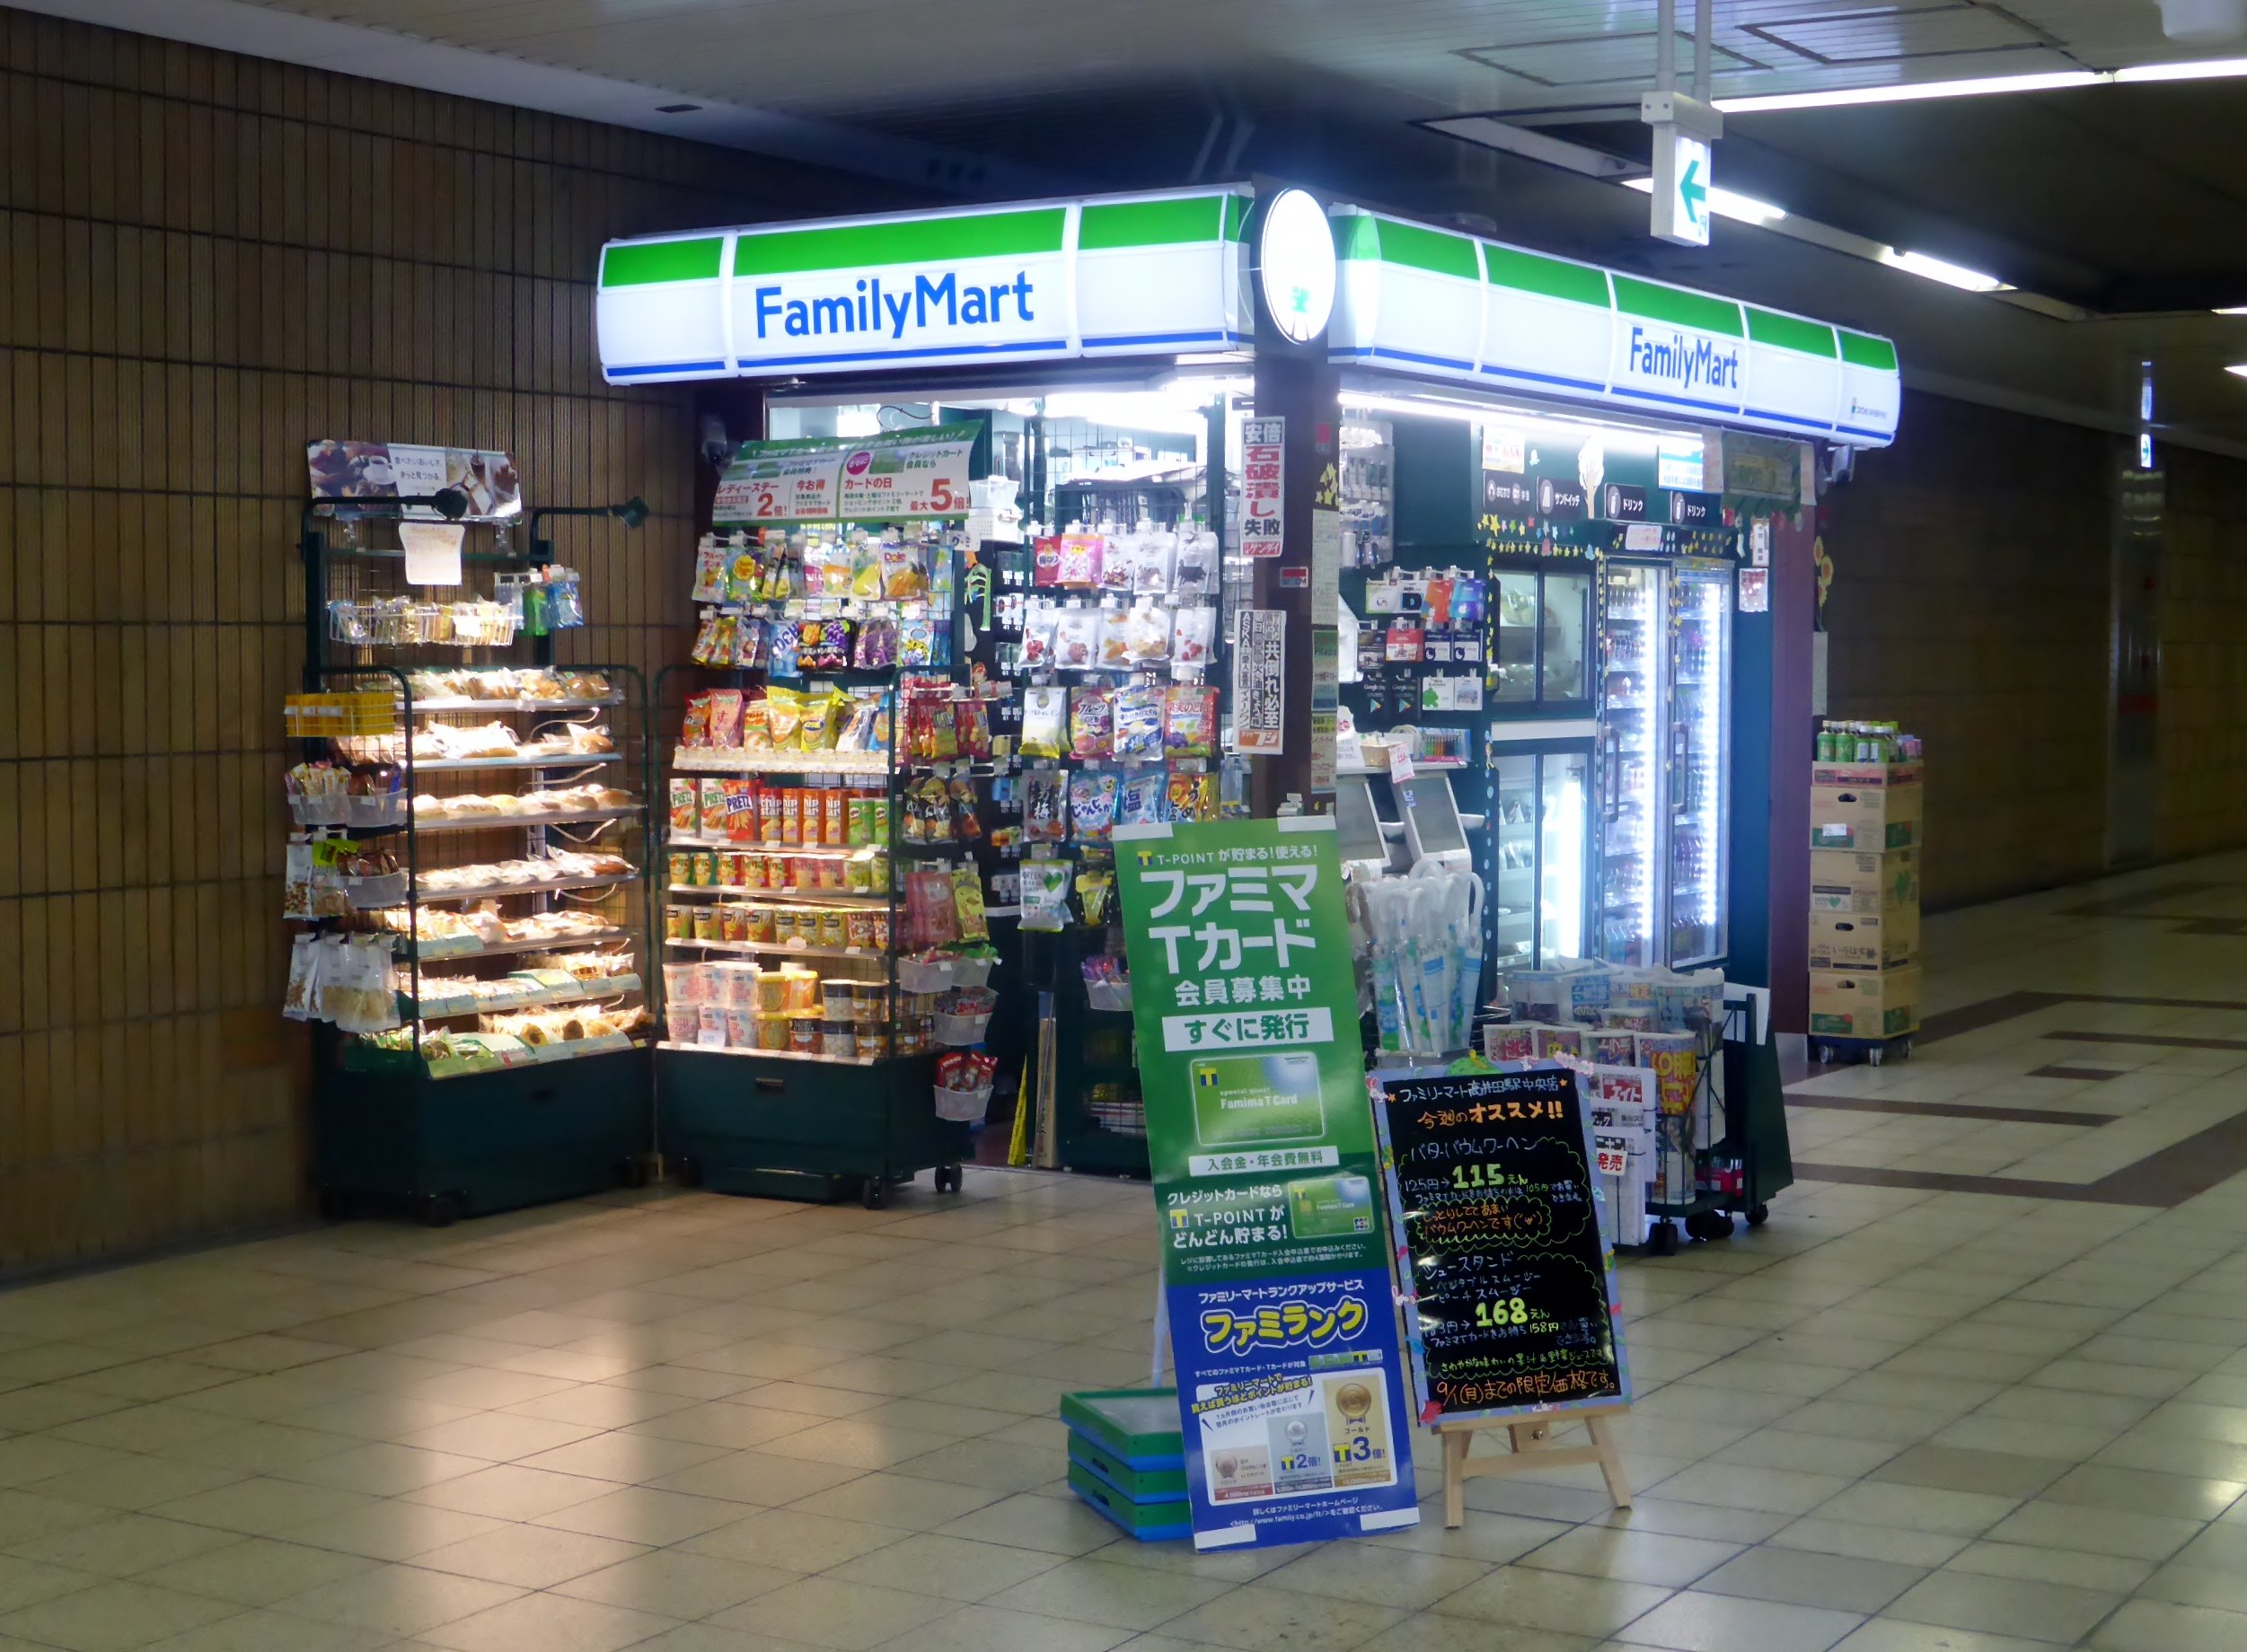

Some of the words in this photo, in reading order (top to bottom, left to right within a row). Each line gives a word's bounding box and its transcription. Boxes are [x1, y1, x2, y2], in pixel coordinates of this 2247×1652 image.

[755, 271, 1034, 338] FamilyMart
[1629, 327, 1739, 391] FamilyMart
[1245, 423, 1282, 444] 安倍
[797, 479, 825, 491] 今お得
[845, 478, 892, 489] カードの日
[1245, 445, 1281, 517] 石破潰し
[1555, 492, 1580, 507] サンドイッチ
[1623, 497, 1643, 512] ドリンク
[1687, 505, 1705, 517] ドリンク
[1245, 519, 1281, 536] 失敗
[885, 552, 906, 562] Dole
[1240, 611, 1253, 647] ASKA
[1079, 703, 1106, 715] フルーツ
[673, 792, 694, 806] PRETZ
[703, 792, 727, 806] PRETZ
[727, 796, 751, 812] PRETZ
[760, 796, 782, 808] chip
[760, 807, 781, 816] star
[1158, 852, 1213, 866] T-POINT
[1219, 844, 1318, 862] が貯まる!使える!
[1141, 865, 1317, 918] ファミマ
[1149, 918, 1316, 974] Tカード
[1175, 974, 1311, 1007] 会員募集中
[1184, 1013, 1310, 1045] すぐに発行
[1399, 1075, 1560, 1103] ファミリーマート高井田駅中央店
[1220, 1096, 1264, 1109] Famima
[1273, 1094, 1298, 1106] Card
[1417, 1100, 1564, 1129] 今週のオススメ!!
[1207, 1150, 1324, 1172] 入会金・年会費無料
[1598, 1152, 1624, 1171] 発売
[1405, 1178, 1439, 1192] 125円
[1168, 1184, 1282, 1207] クレジットカードなら
[1194, 1208, 1265, 1226] T-POINT
[1174, 1226, 1288, 1250] どんどん貯まる!
[1199, 1279, 1364, 1304] ファミリーマートランクアップサービス
[1203, 1299, 1364, 1348] ファミランク
[1191, 1375, 1313, 1414] 買えば買うほどポイントが貯まる!
[1214, 1373, 1282, 1396] ファミリーマートで
[1296, 1454, 1321, 1469] 2倍!
[1252, 1497, 1359, 1516] 詳しくはファミリーマートホームページ
